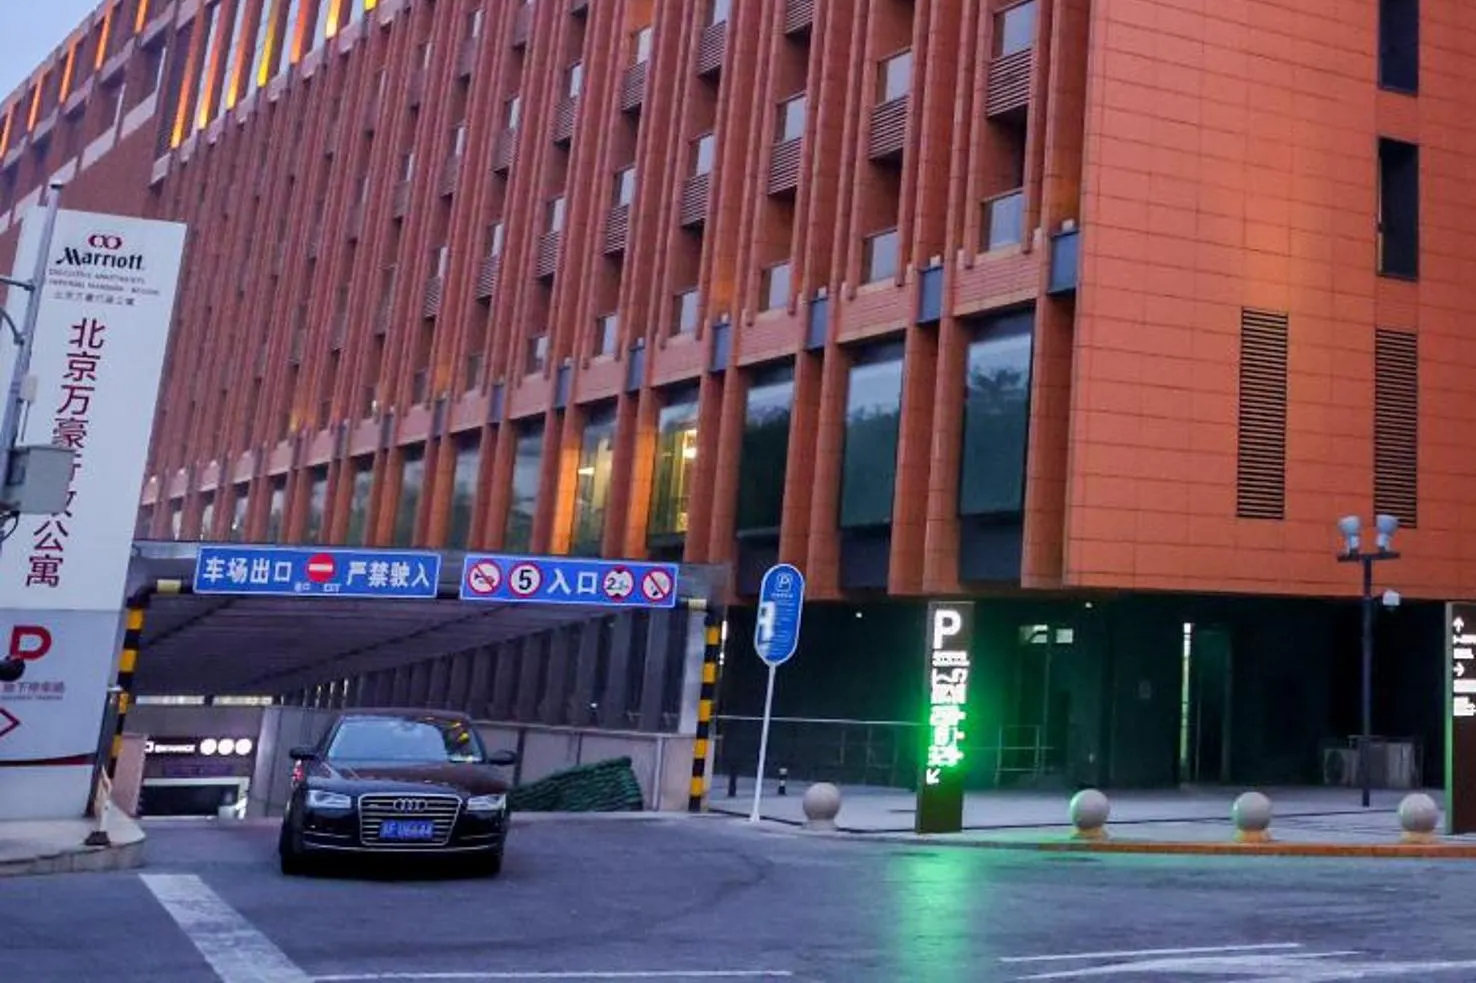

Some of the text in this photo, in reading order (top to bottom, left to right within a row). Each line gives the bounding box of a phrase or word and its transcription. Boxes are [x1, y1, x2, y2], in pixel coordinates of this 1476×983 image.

[56, 247, 143, 270] Marriott
[203, 557, 430, 587] 车场出口 严禁驶入
[518, 569, 532, 591] 5
[547, 568, 598, 595] 入口
[10, 625, 52, 661] P
[933, 609, 961, 649] P
